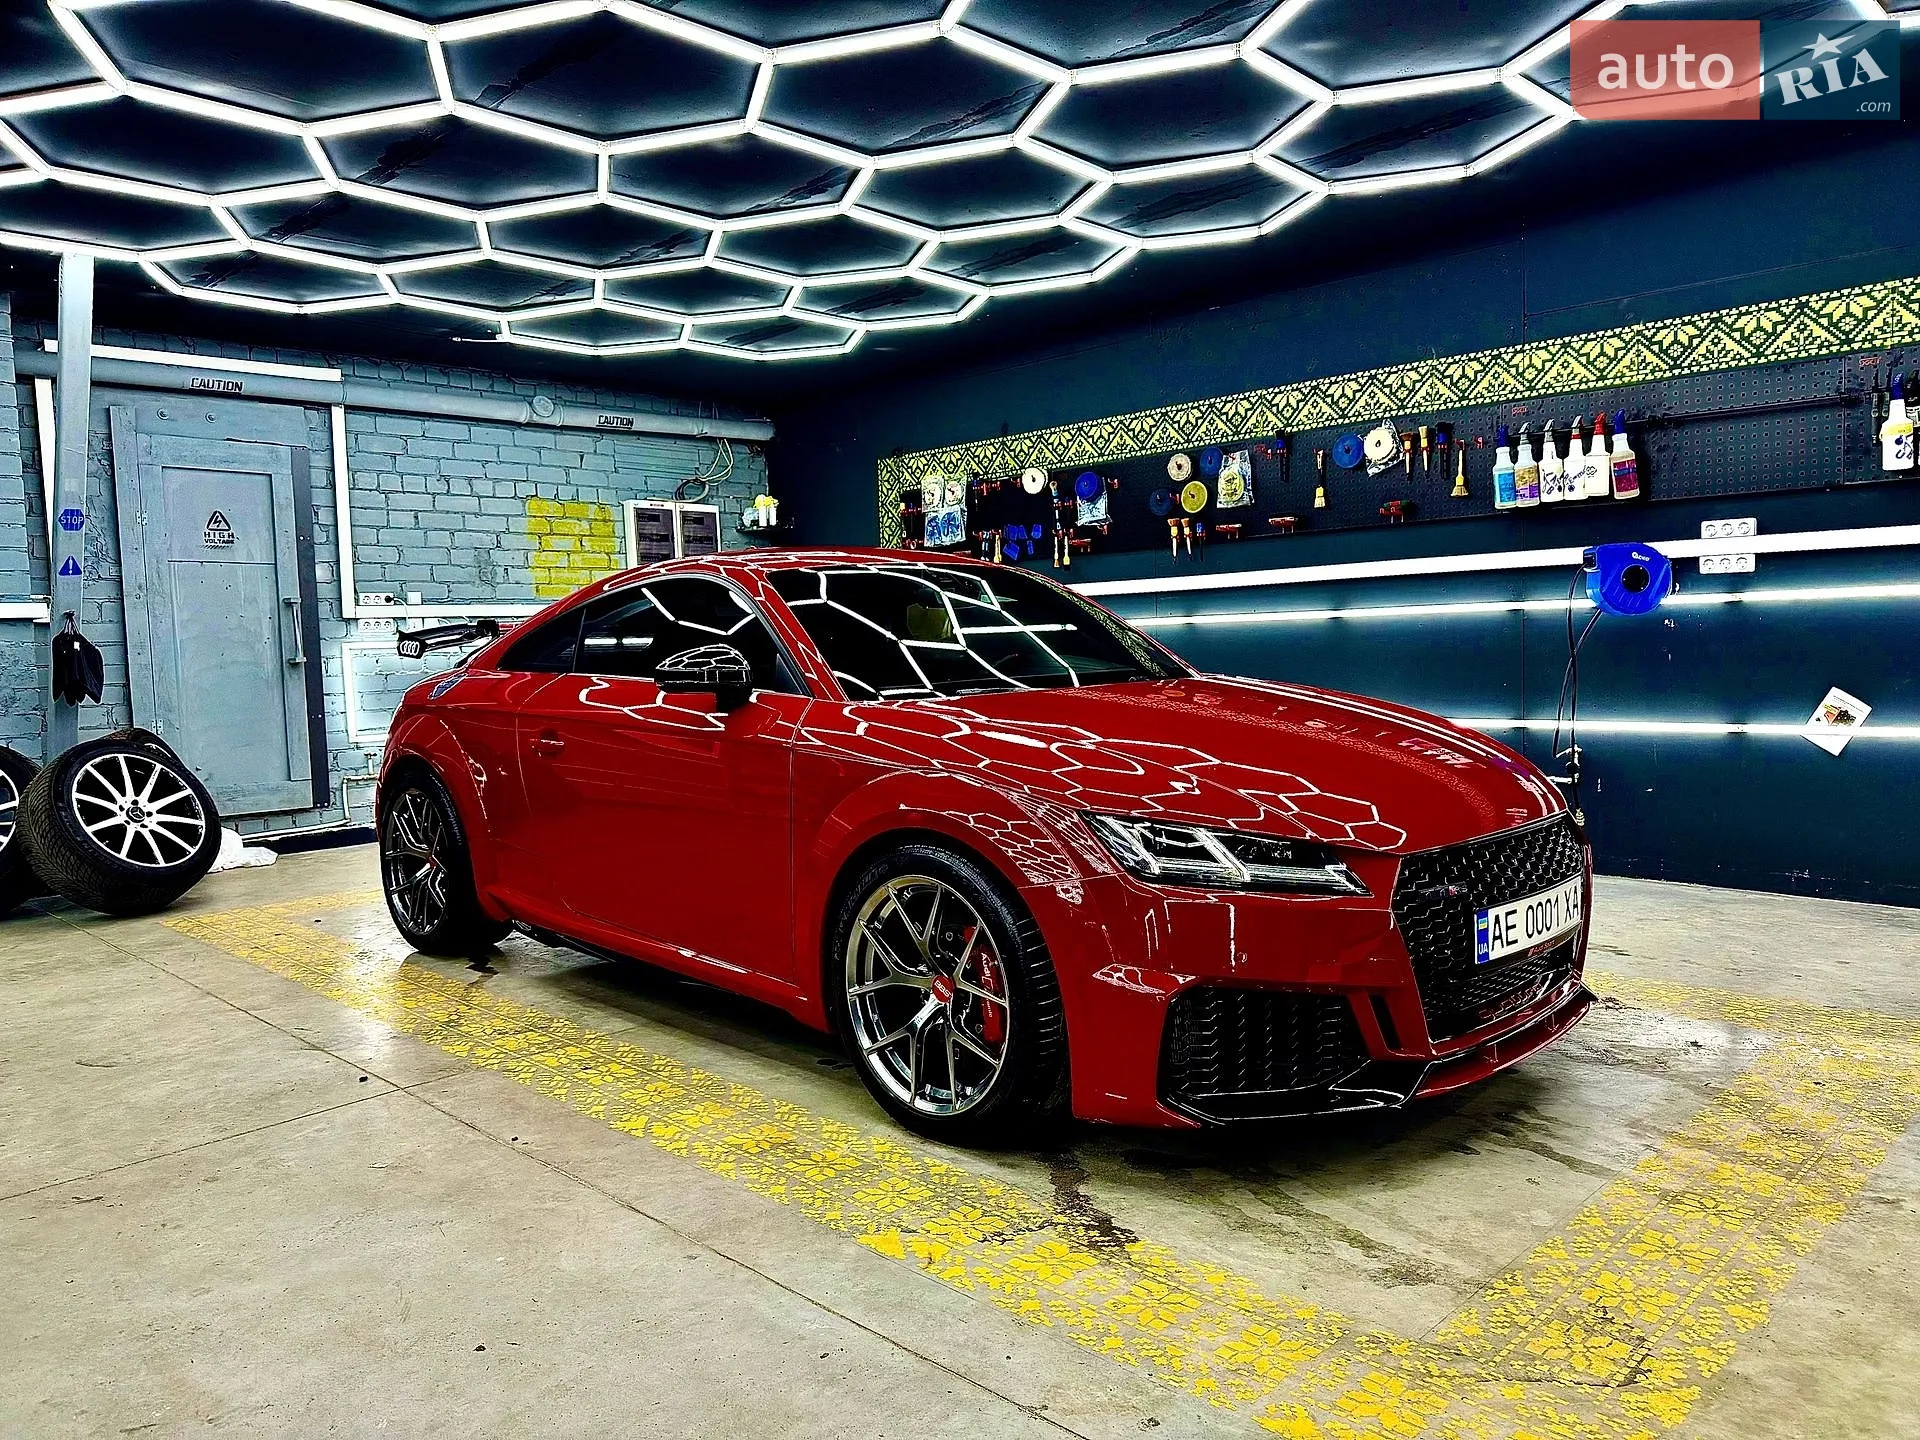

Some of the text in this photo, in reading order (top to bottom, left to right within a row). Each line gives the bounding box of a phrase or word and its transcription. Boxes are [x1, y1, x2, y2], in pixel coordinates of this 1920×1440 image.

[190, 377, 244, 392] CAUTION
[598, 415, 634, 427] CAUTION
[60, 515, 84, 524] STOP
[203, 531, 235, 539] HIGH
[1491, 884, 1580, 953] AE 0001 XA
[1478, 942, 1489, 955] UA
[981, 952, 992, 977] Audi
